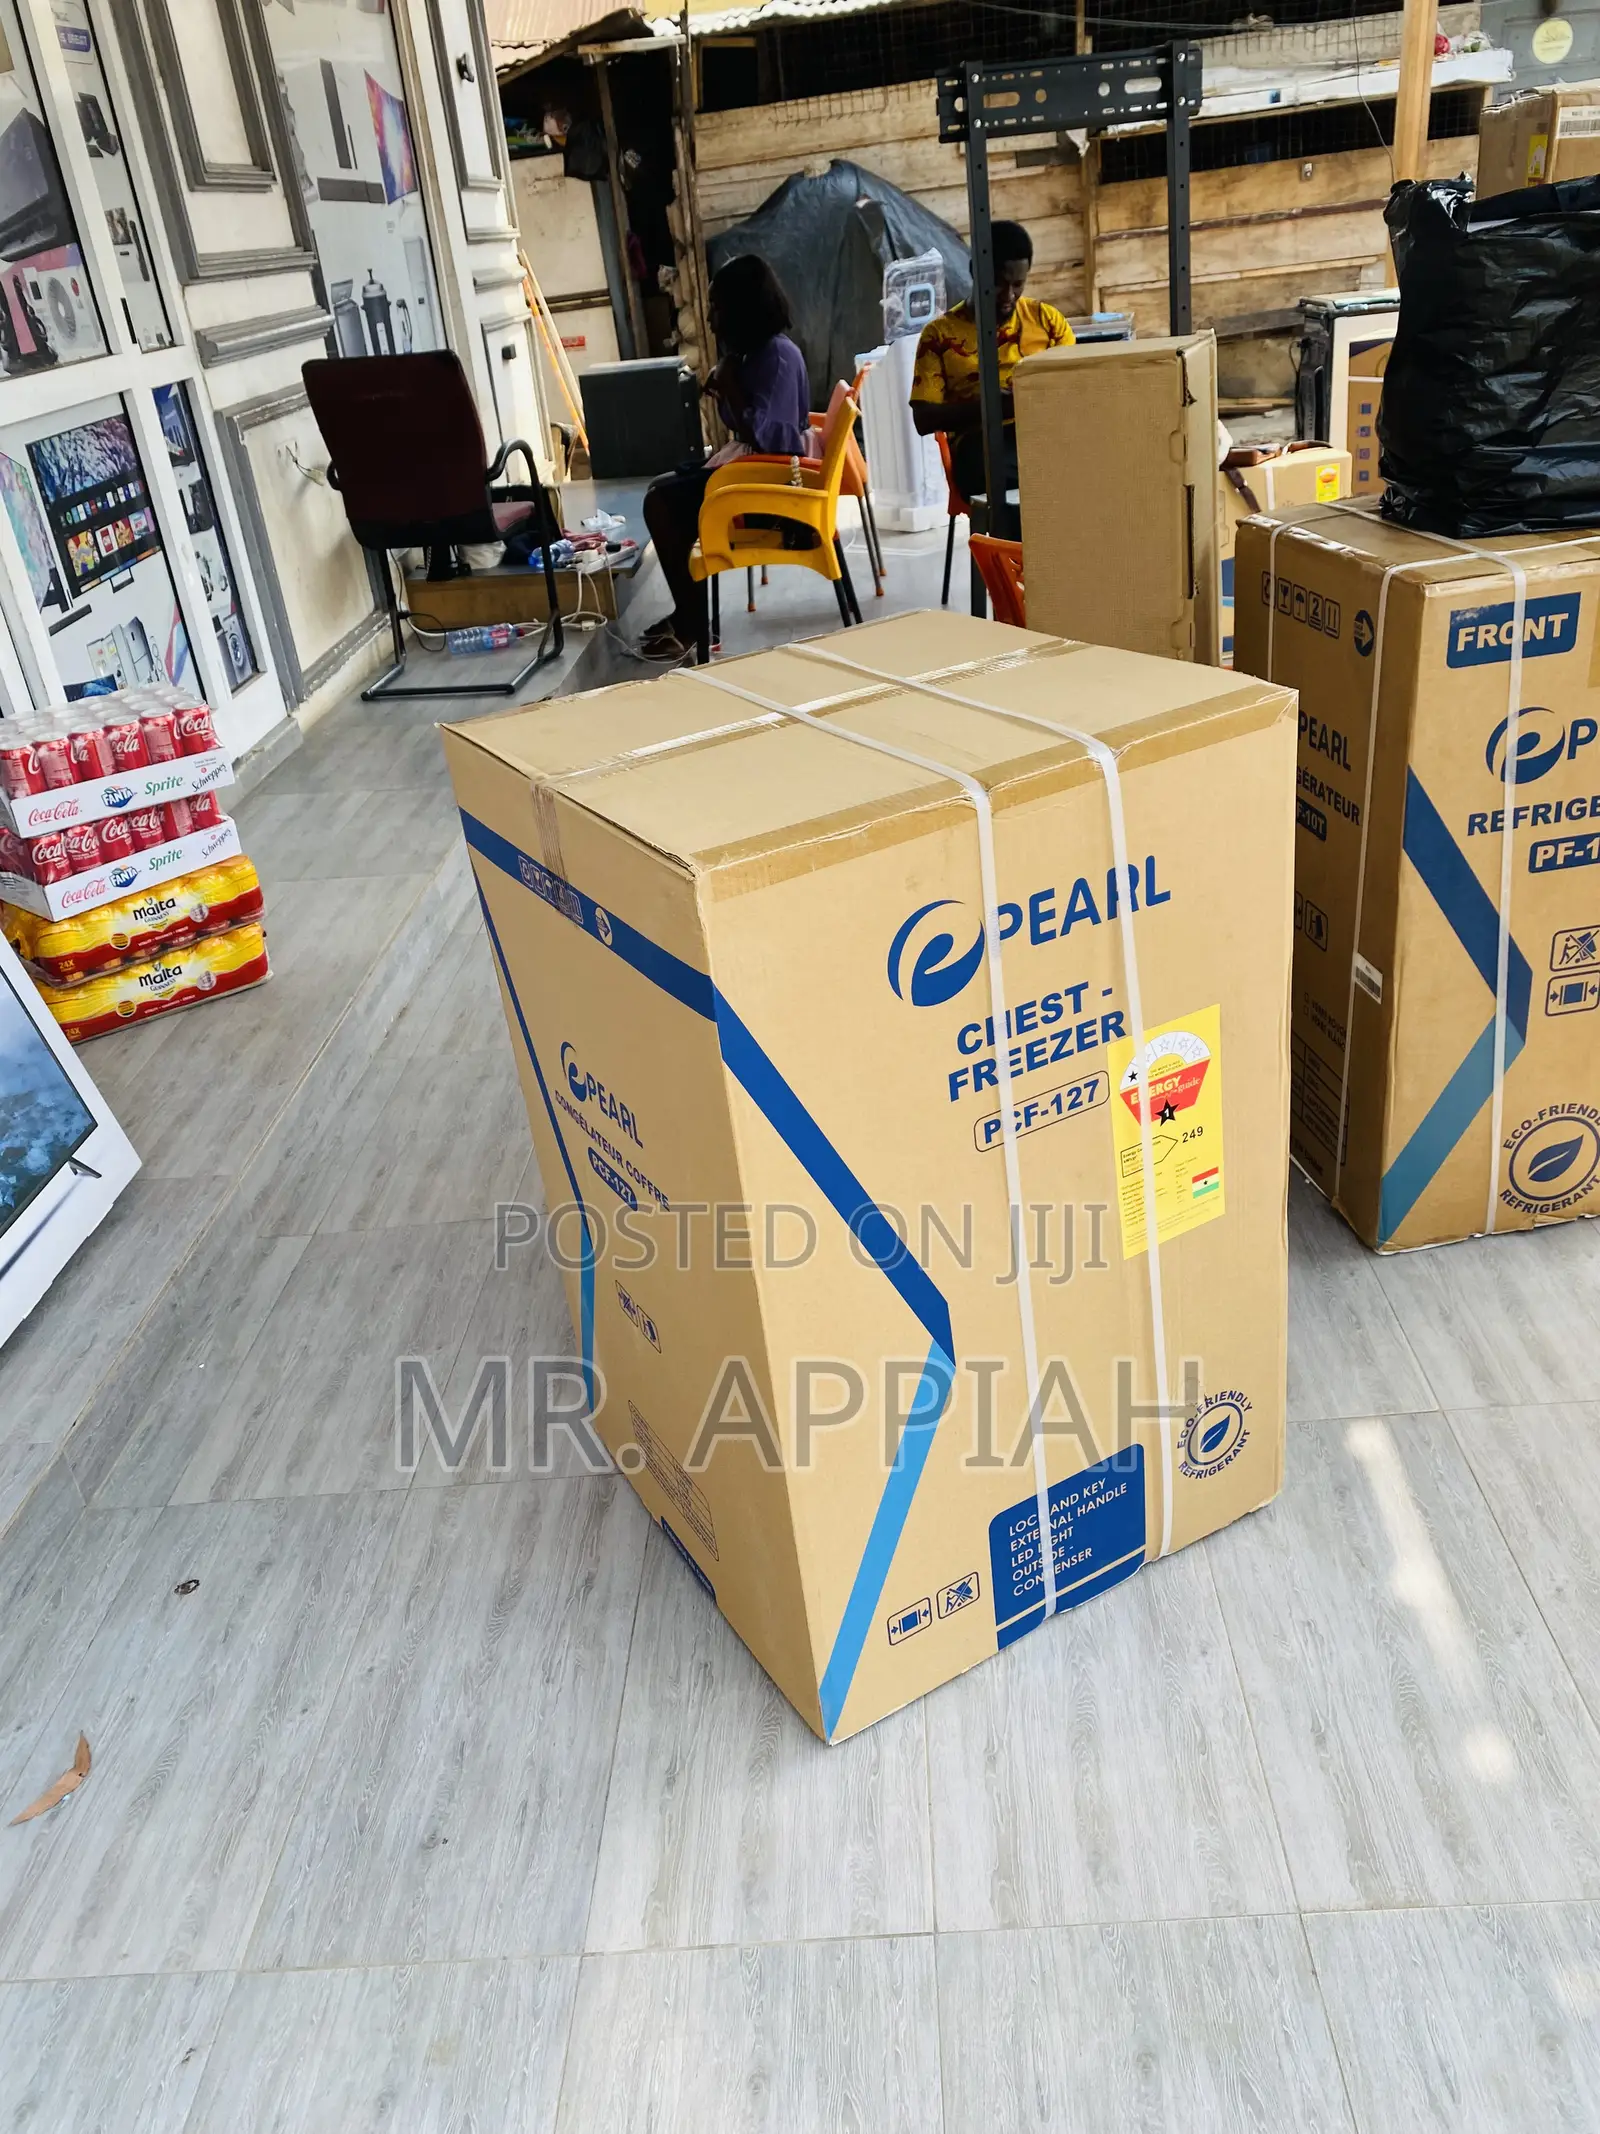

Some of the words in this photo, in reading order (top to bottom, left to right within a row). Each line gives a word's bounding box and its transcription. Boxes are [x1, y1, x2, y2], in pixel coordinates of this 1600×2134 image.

[1456, 613, 1569, 652] FRONT
[28, 799, 79, 826] Coca-Cola
[102, 787, 134, 806] FANTA
[144, 776, 183, 795] Sprite
[191, 762, 226, 792] Schweppes
[62, 880, 106, 908] Coca-Cola
[109, 867, 138, 886] FANTA
[149, 850, 183, 871] Sprite
[201, 829, 231, 859] Schweppes
[133, 898, 176, 921] Malta
[990, 855, 1171, 946] PEARL
[139, 965, 182, 987] Malta
[949, 1010, 1127, 1103] FREEZER
[586, 1072, 644, 1148] PEARL
[1130, 1075, 1182, 1105] EERGY
[1177, 1076, 1201, 1094] guide
[555, 1090, 624, 1169] CONGÉLATEUR
[625, 1160, 671, 1212] COFFRE
[1181, 1126, 1204, 1144] 249
[591, 1155, 633, 1202] PCF-127
[1499, 1175, 1600, 1214] REFRIGERANT
[1177, 1390, 1252, 1449] ECO-FRIENDLY
[1178, 1429, 1250, 1479] REFRIGERANT
[1009, 1512, 1044, 1537] LOC
[1049, 1493, 1079, 1515] AND
[1083, 1478, 1106, 1498] KEY
[1010, 1516, 1073, 1552] EXTENAL
[1077, 1483, 1127, 1517] HANDLE
[1011, 1548, 1033, 1568] LED
[1038, 1526, 1073, 1554] LGHT
[1012, 1546, 1065, 1582] OUTSDE
[1013, 1547, 1092, 1597] CONENSER
